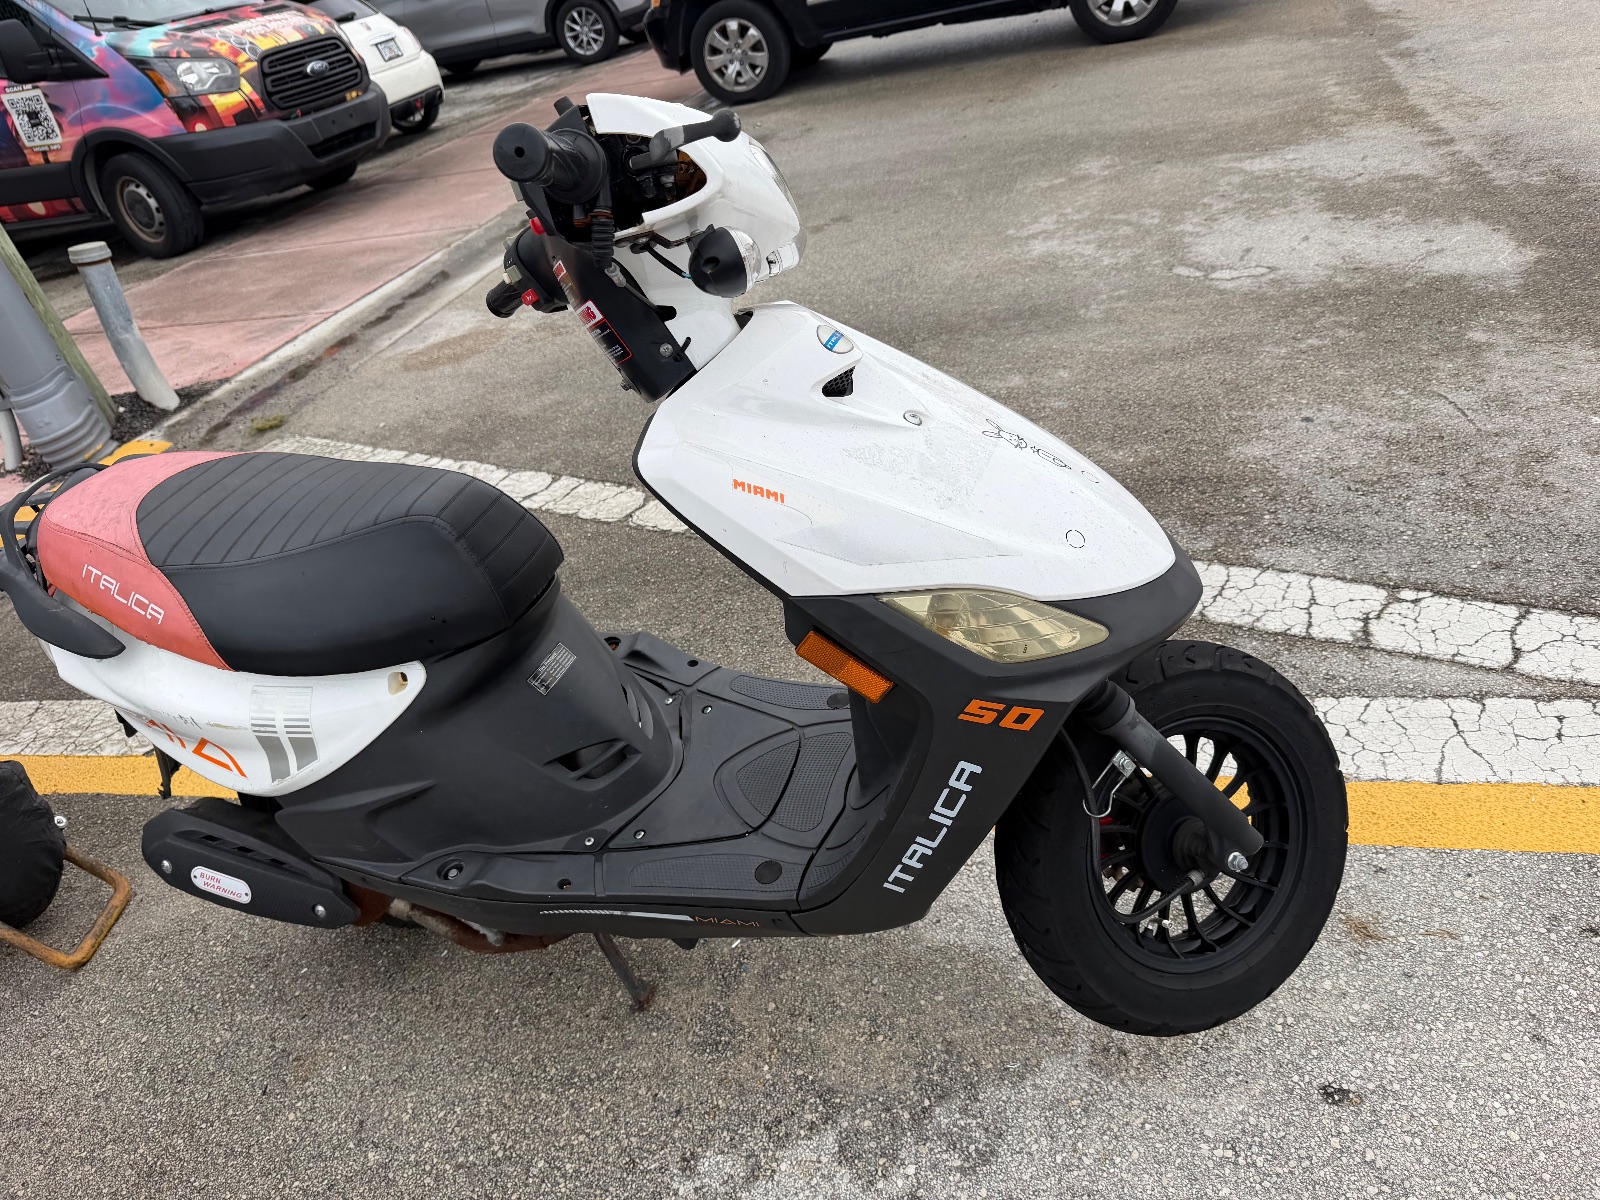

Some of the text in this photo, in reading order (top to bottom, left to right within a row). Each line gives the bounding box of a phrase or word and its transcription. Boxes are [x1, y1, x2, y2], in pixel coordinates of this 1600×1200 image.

[733, 479, 785, 504] MIAMI
[82, 563, 165, 625] ITALICA
[957, 698, 1045, 732] 50
[883, 760, 983, 893] ITALICA
[199, 871, 222, 884] BURN
[203, 880, 243, 899] WARNING
[695, 915, 760, 928] MIAMI
